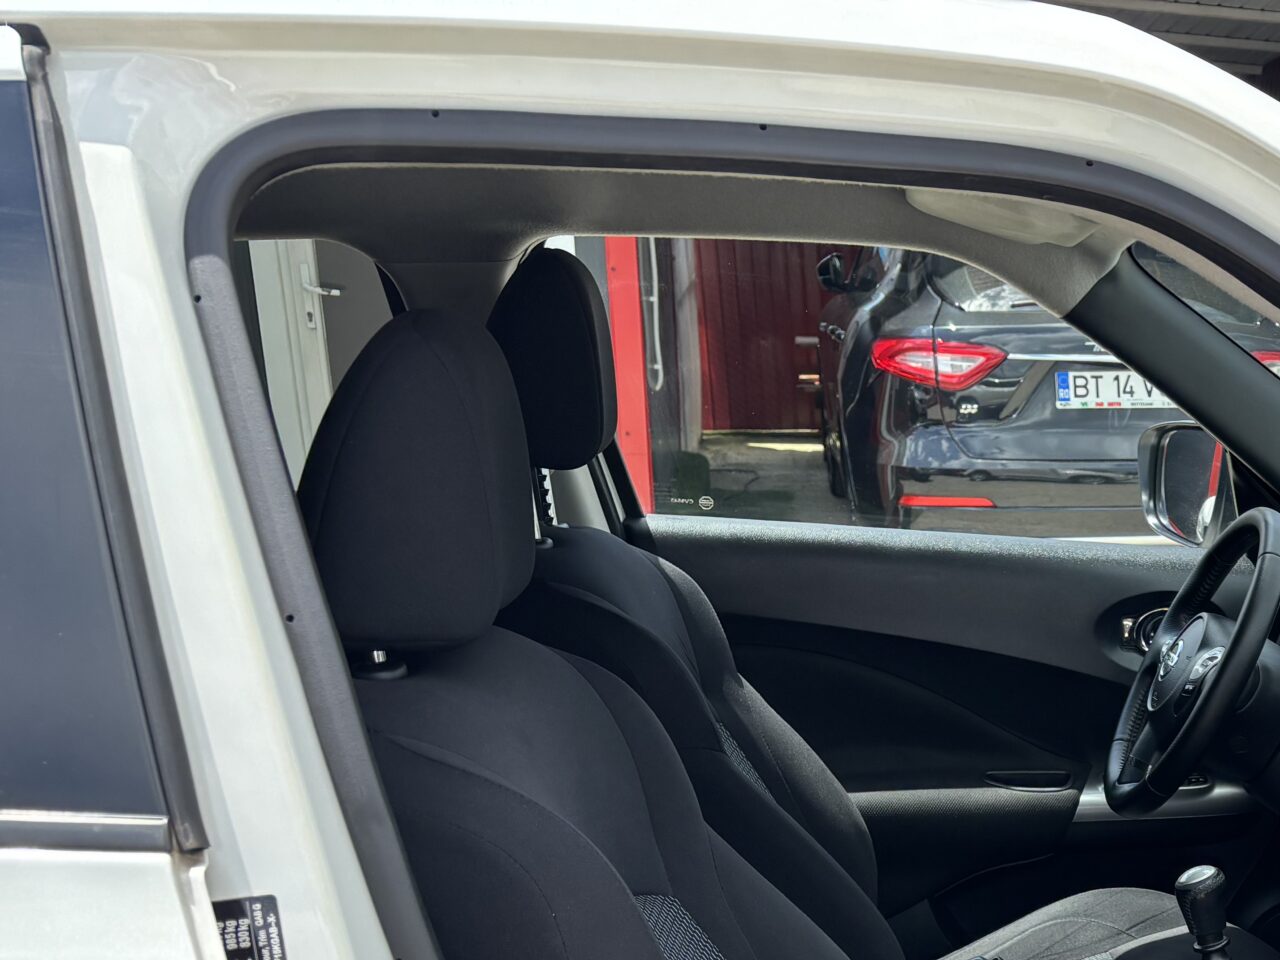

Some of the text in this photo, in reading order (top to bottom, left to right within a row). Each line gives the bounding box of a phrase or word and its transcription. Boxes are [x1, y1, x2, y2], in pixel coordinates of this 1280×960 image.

[1073, 375, 1102, 398] BT
[1113, 375, 1134, 397] 14
[225, 920, 237, 932] kg
[238, 918, 251, 931] kg
[225, 931, 238, 950] 985
[238, 931, 251, 949] 830
[258, 929, 269, 948] Trim
